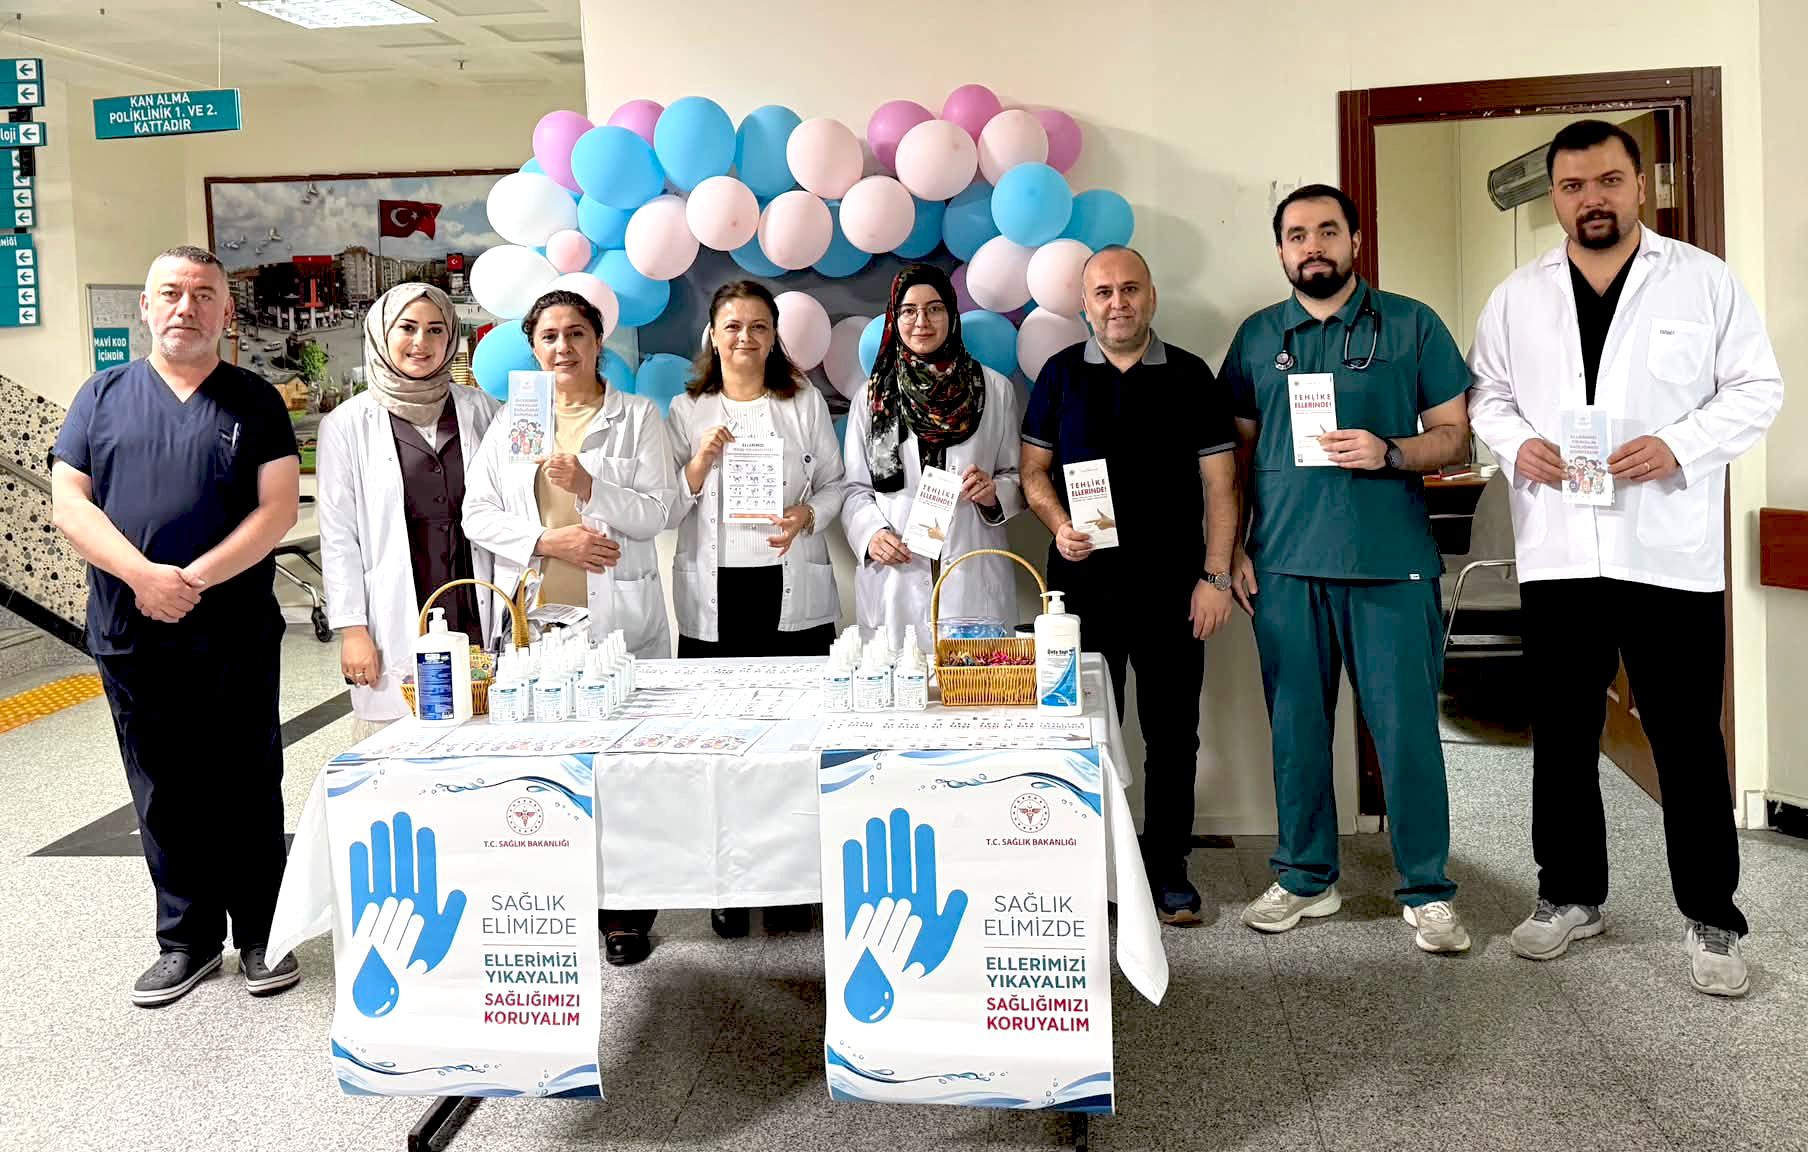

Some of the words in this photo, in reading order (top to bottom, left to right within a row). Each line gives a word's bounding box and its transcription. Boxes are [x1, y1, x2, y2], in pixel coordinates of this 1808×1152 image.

[130, 94, 154, 108] KAN
[157, 92, 191, 106] ALMA
[109, 105, 172, 125] POLİKLİNİK
[175, 106, 186, 118] 1.
[187, 104, 204, 117] VE
[206, 103, 218, 116] 2.
[133, 118, 192, 134] KATTADIR
[112, 337, 127, 347] KOD
[483, 840, 498, 848] T.C.
[498, 839, 526, 848] SAĞLIK
[527, 838, 570, 848] BAKANLIĞI
[986, 838, 1000, 846] T.C.
[1002, 837, 1031, 846] SAĞLIK
[1032, 837, 1077, 847] BAKANLIĞI
[491, 892, 566, 911] SAĞLIK
[994, 892, 1073, 913] SAĞLIK
[482, 914, 577, 935] ELİMİZDE
[984, 916, 1086, 937] ELİMİZDE
[484, 951, 578, 967] ELLERİMİZİ
[986, 954, 1086, 972] ELLERİMİZİ
[485, 970, 579, 984] YIKAYALIM
[986, 974, 1086, 989] YIKAYALIM
[484, 990, 580, 1008] SAĞLIĞIMIZI
[986, 994, 1089, 1012] SAĞLIĞIMIZI
[484, 1010, 580, 1026] KORUYALIM
[987, 1015, 1090, 1032] KORUYALIM
